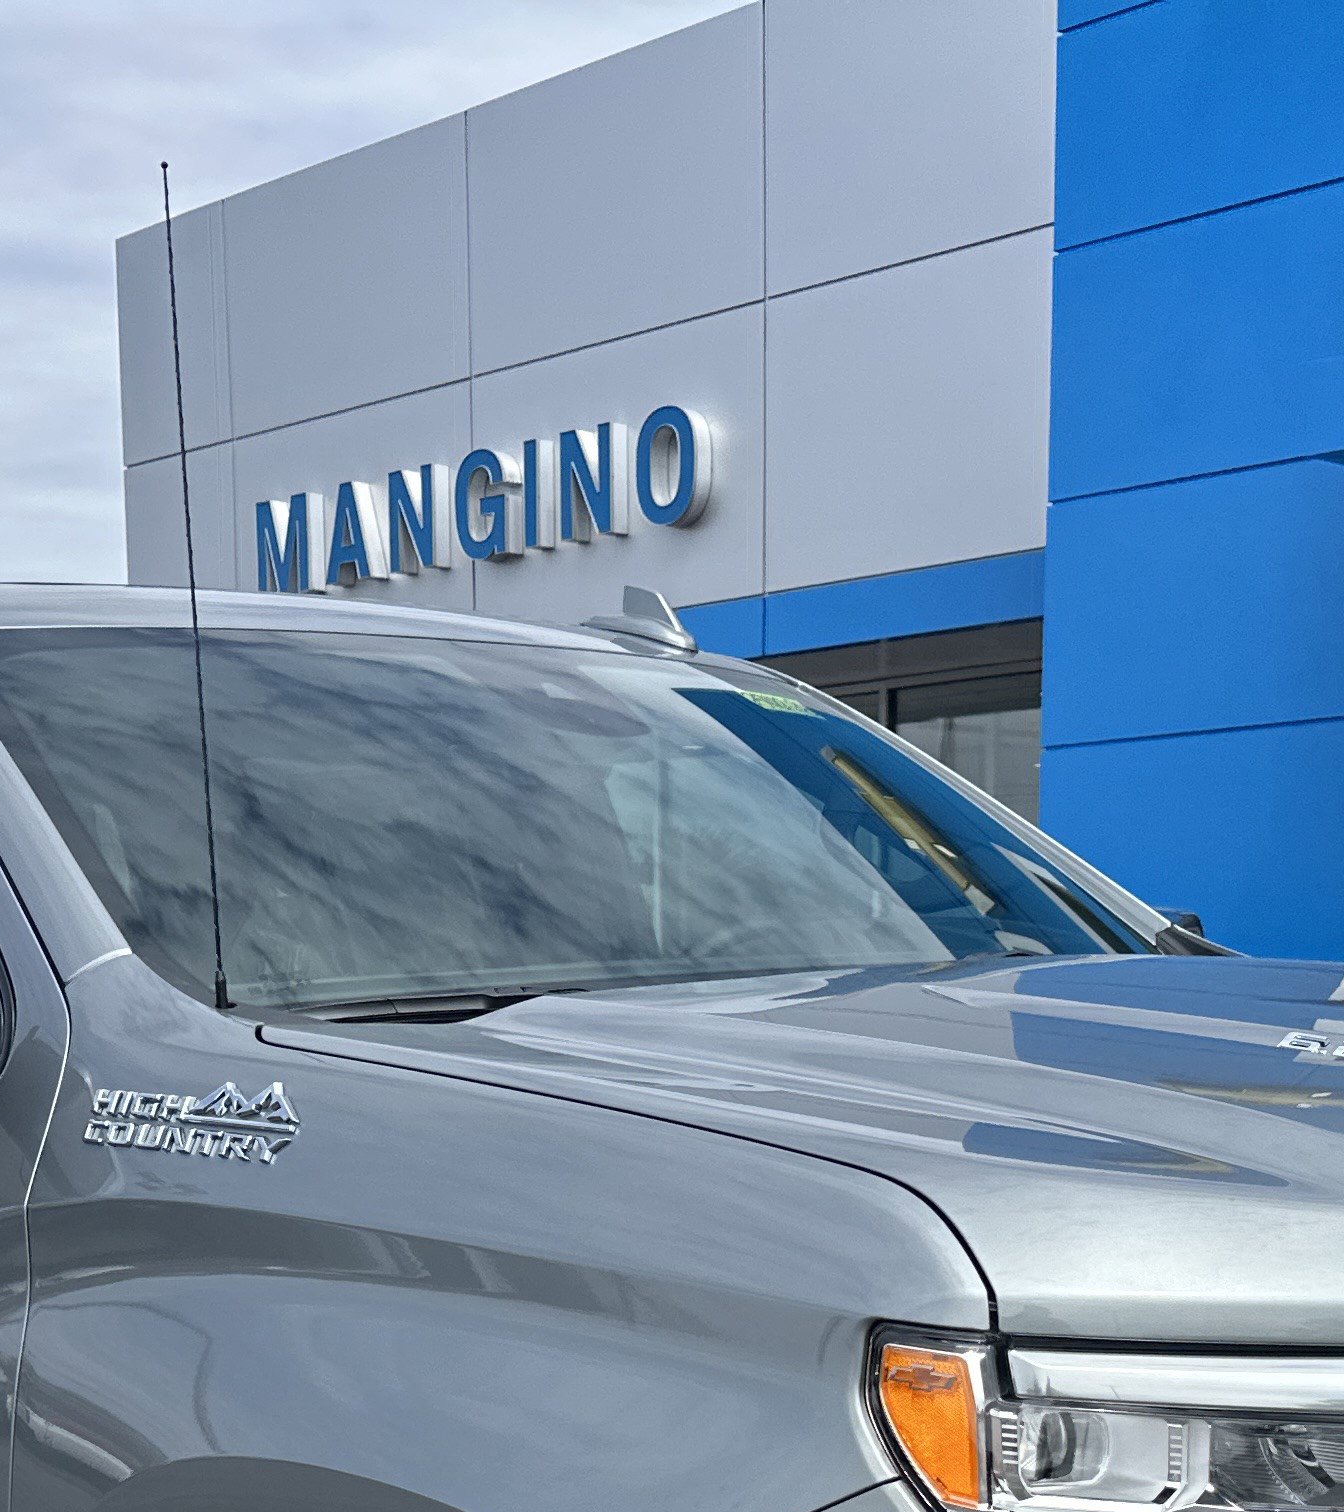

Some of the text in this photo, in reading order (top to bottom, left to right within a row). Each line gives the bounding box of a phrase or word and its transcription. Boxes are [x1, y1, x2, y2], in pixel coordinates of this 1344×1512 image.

[256, 404, 713, 594] MANGINO
[89, 1088, 199, 1122] HIGH
[82, 1119, 292, 1164] COUNTRY
